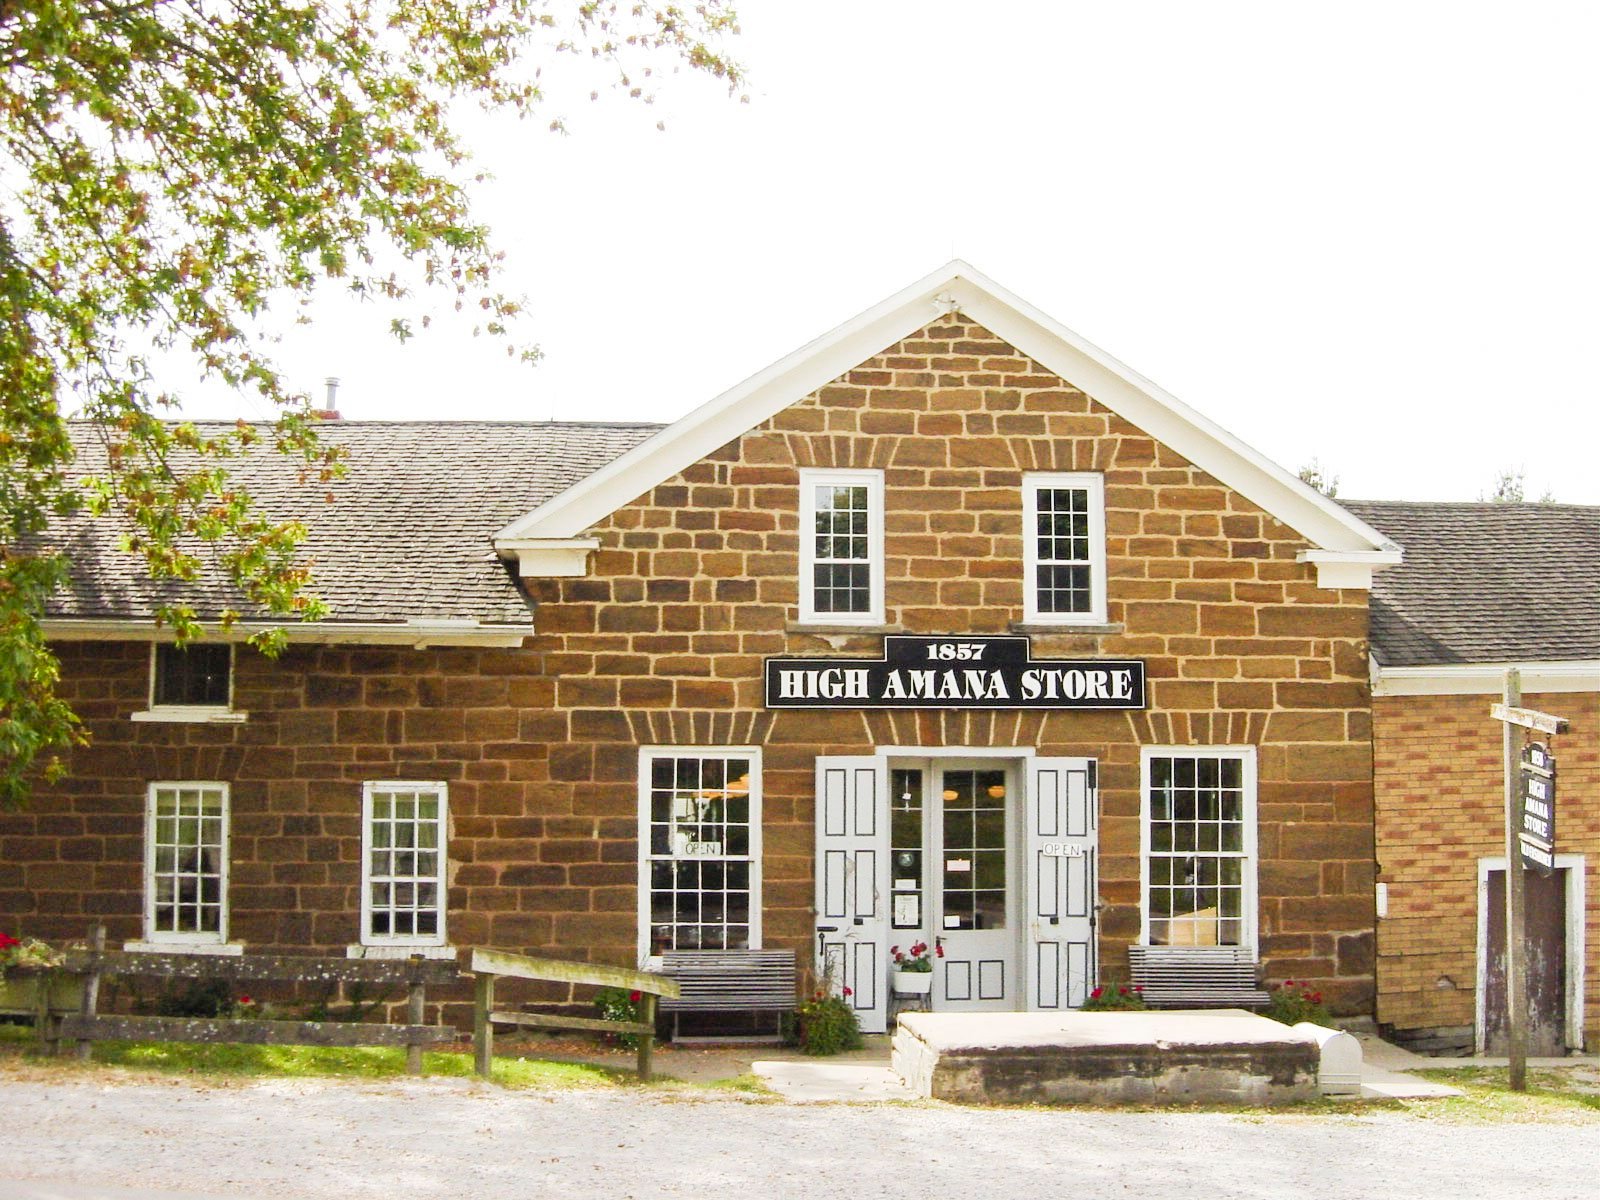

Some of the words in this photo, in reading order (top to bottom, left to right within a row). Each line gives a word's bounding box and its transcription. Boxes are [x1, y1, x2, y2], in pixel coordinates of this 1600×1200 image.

[926, 643, 987, 660] 1857
[778, 668, 870, 699] HIGH
[881, 669, 1010, 700] AMANA
[1021, 669, 1133, 701] STORE
[1529, 779, 1545, 799] HIGH
[1524, 814, 1548, 837] STORE
[1044, 843, 1080, 856] OPEN
